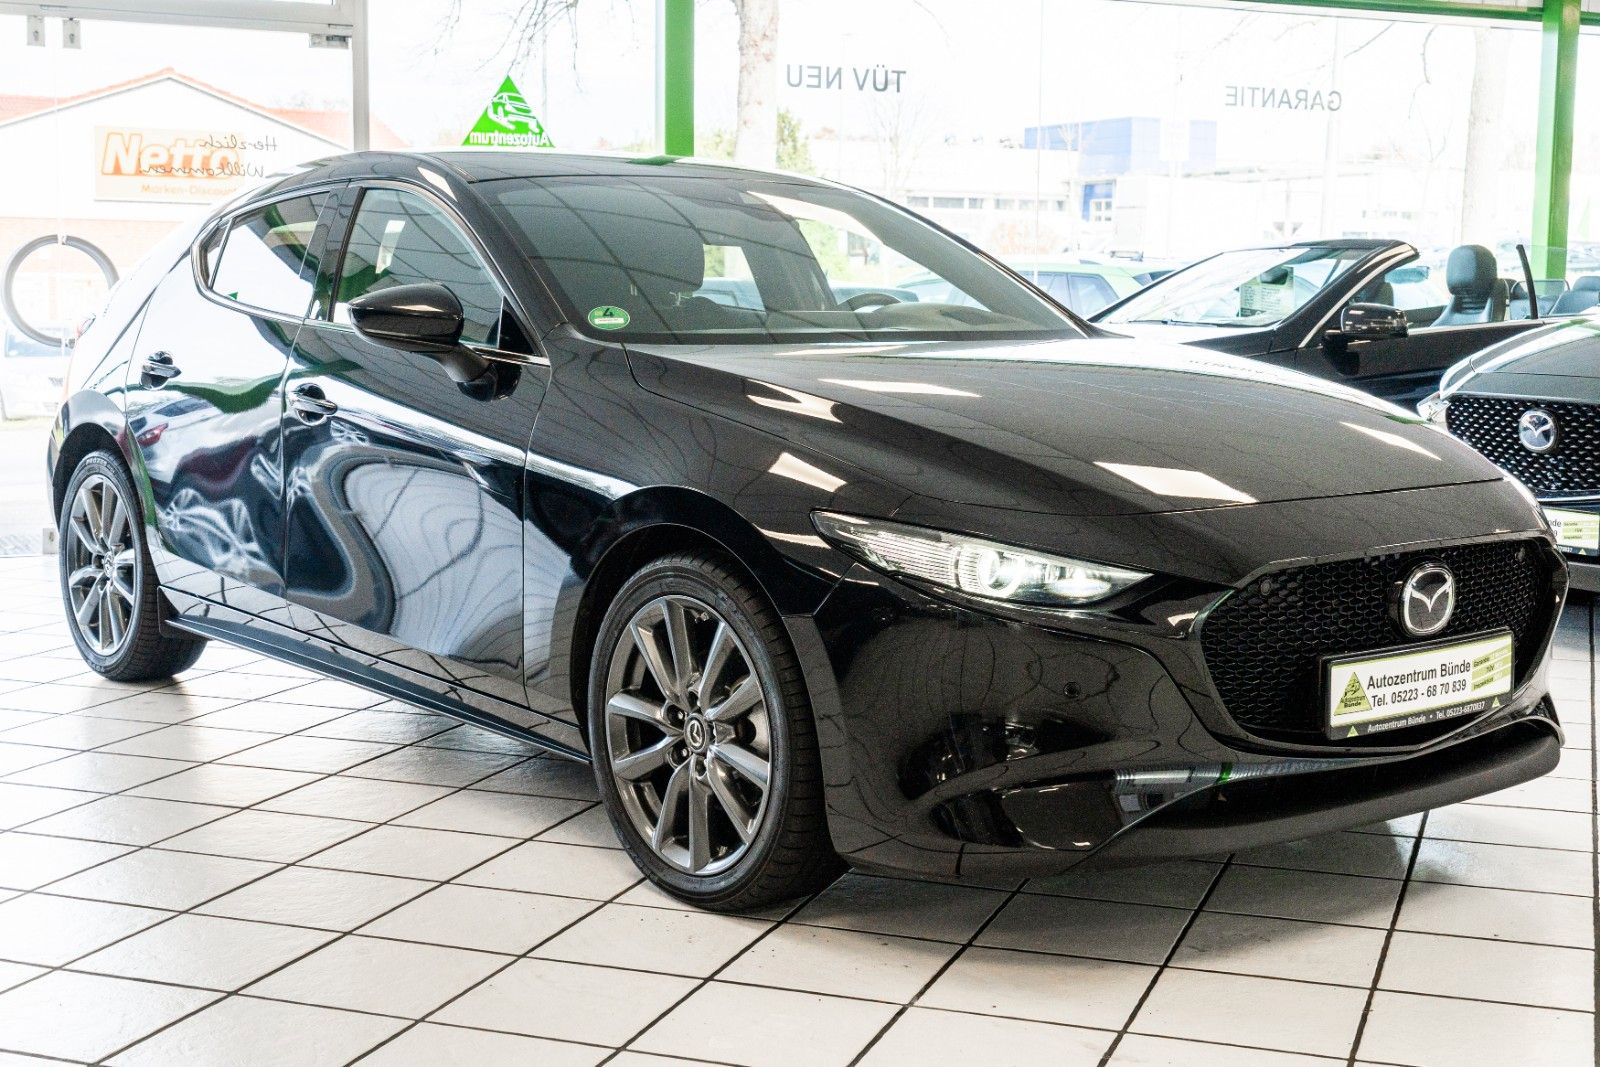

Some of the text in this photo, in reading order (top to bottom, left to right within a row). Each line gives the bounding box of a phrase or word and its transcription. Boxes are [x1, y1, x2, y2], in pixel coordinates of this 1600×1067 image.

[101, 132, 241, 180] Netto
[1367, 659, 1471, 690] Autozentrum Bünde
[1371, 693, 1388, 708] Tel.
[1391, 688, 1419, 704] 05223
[1427, 684, 1438, 698] 68
[1440, 682, 1450, 696] 70
[1451, 678, 1467, 693] 839
[1367, 719, 1407, 733] Autozentrum
[1407, 713, 1427, 725] Bünde
[1435, 710, 1446, 720] Tel.
